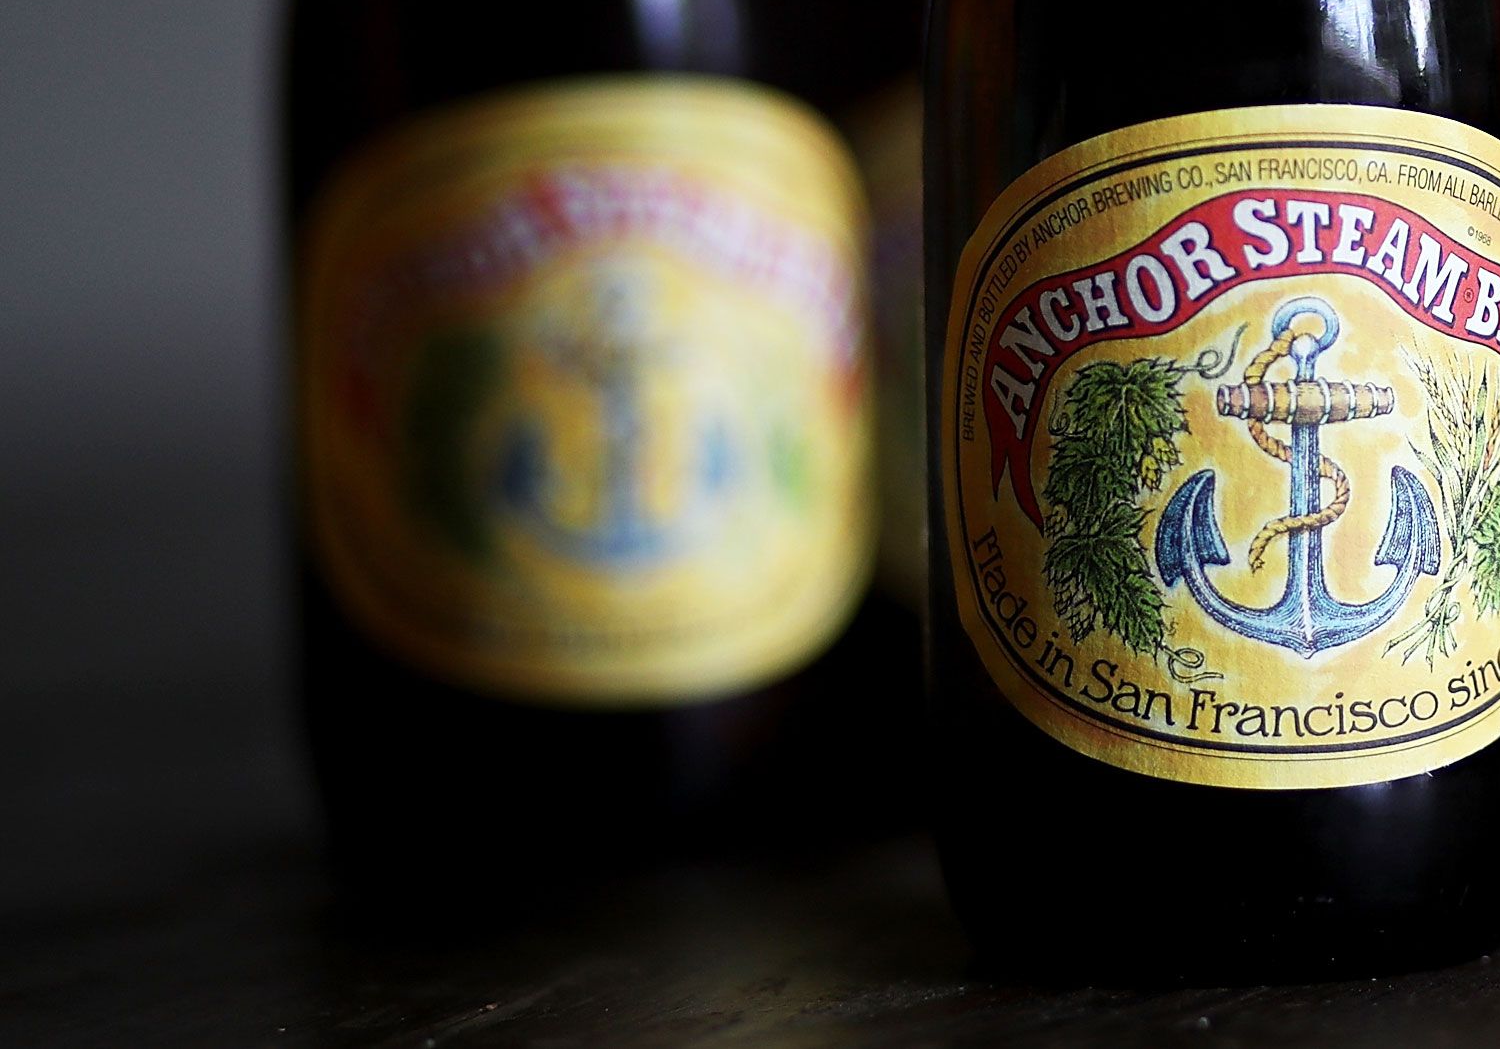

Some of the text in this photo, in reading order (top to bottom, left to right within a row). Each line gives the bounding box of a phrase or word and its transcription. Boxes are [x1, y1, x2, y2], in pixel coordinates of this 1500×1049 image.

[962, 366, 975, 442] BREWED
[970, 324, 985, 362] AND
[981, 258, 1018, 325] BOTTLED
[1014, 237, 1030, 264] BY
[1033, 200, 1092, 250] ANCHOR
[1092, 171, 1173, 214] BREWING
[1215, 161, 1251, 184] SAN
[1258, 159, 1362, 186] FRANCISCO,
[1366, 160, 1392, 184] CA.
[1398, 164, 1443, 193] FROM
[1443, 175, 1467, 201] ALL
[990, 221, 1236, 441] ANCHOR
[1232, 198, 1469, 325] STEAM
[972, 526, 1038, 649] Made
[1035, 632, 1074, 688] in
[1079, 659, 1176, 726] San
[1186, 688, 1438, 737] Francisco
